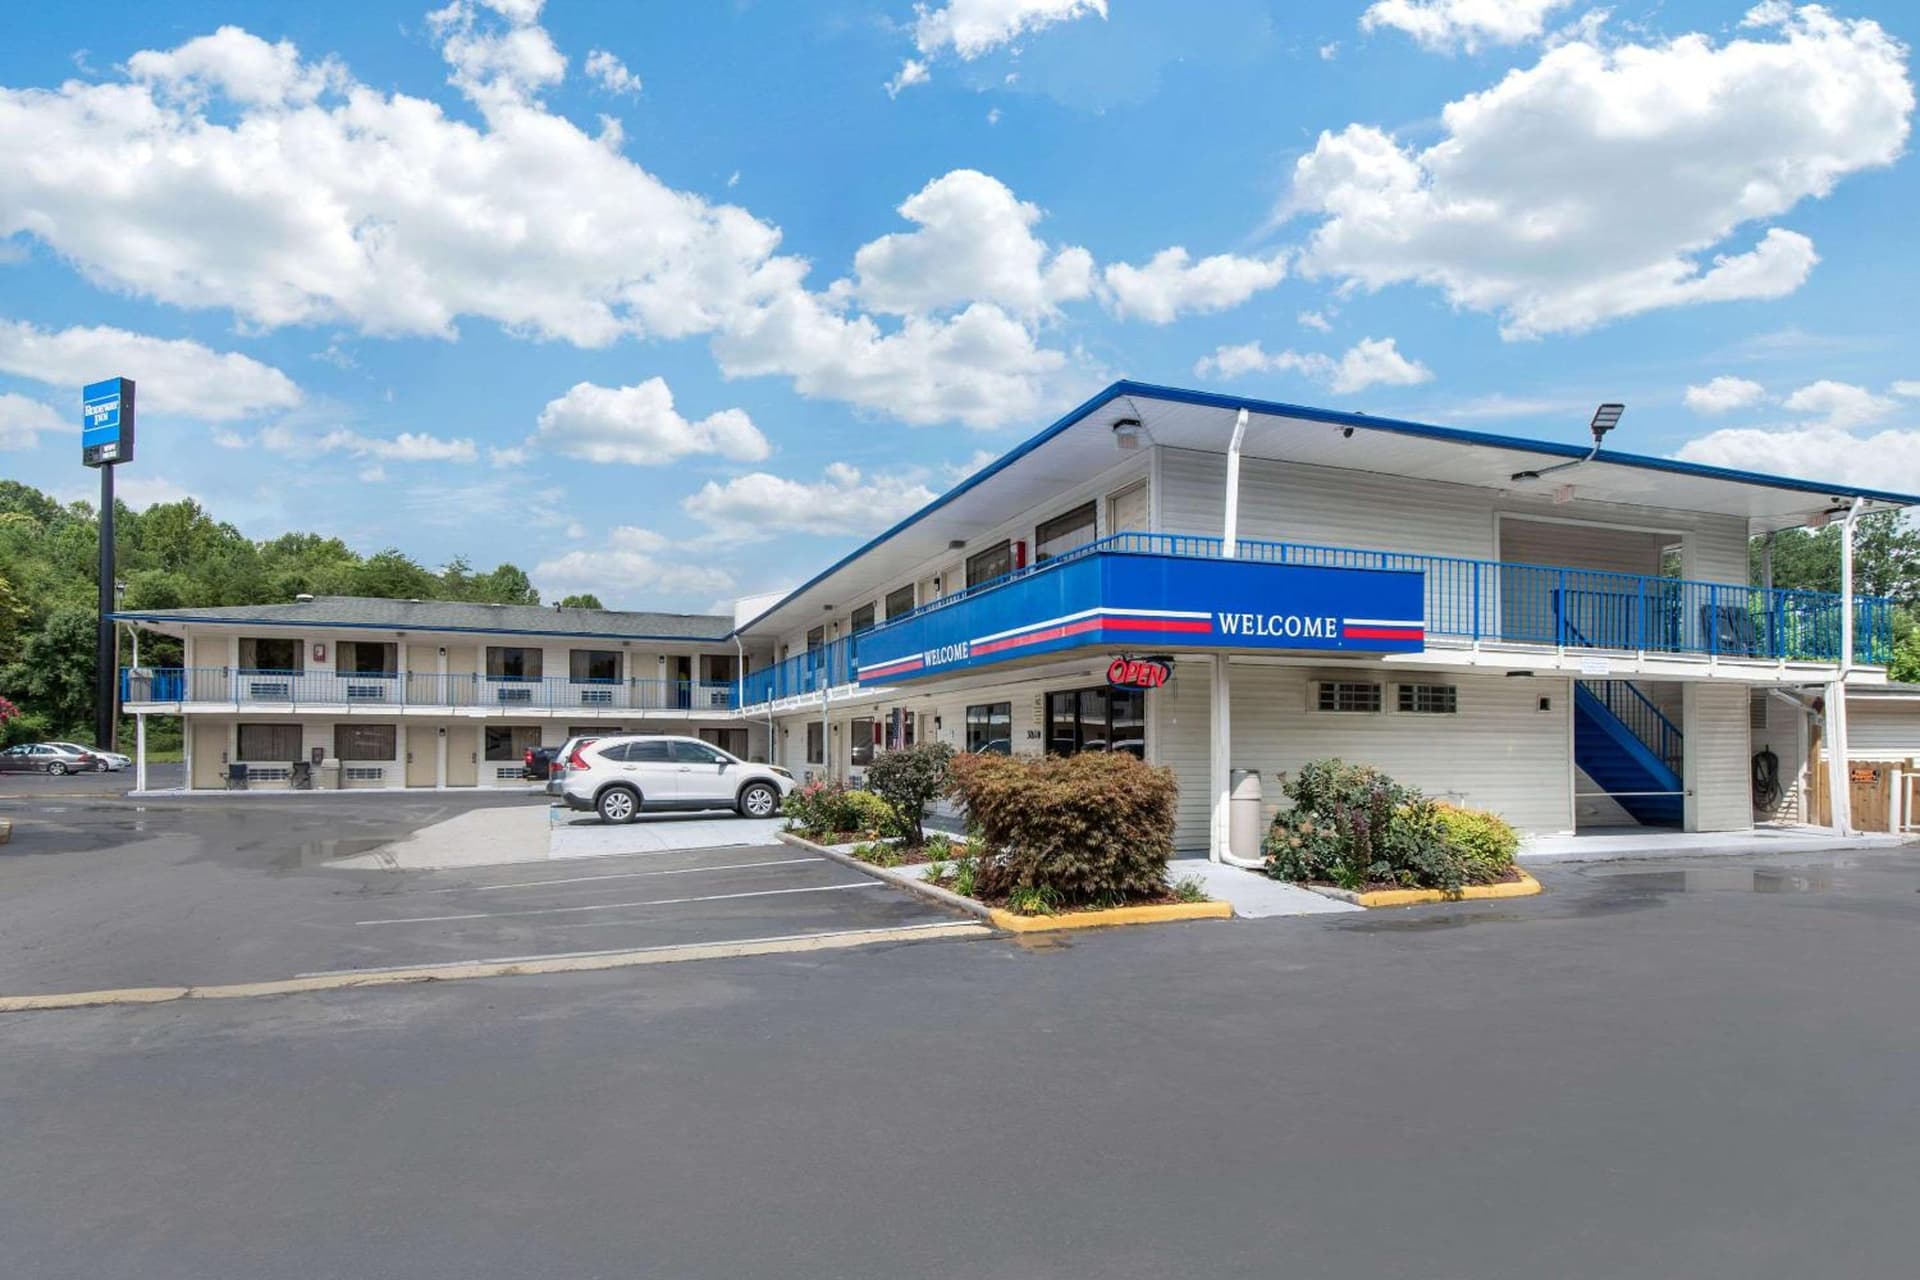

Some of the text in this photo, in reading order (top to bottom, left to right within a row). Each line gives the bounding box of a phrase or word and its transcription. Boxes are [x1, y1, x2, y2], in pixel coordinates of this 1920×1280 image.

[1218, 612, 1337, 638] WELCOME
[924, 641, 969, 667] WELCOME
[1108, 659, 1168, 688] OPEN
